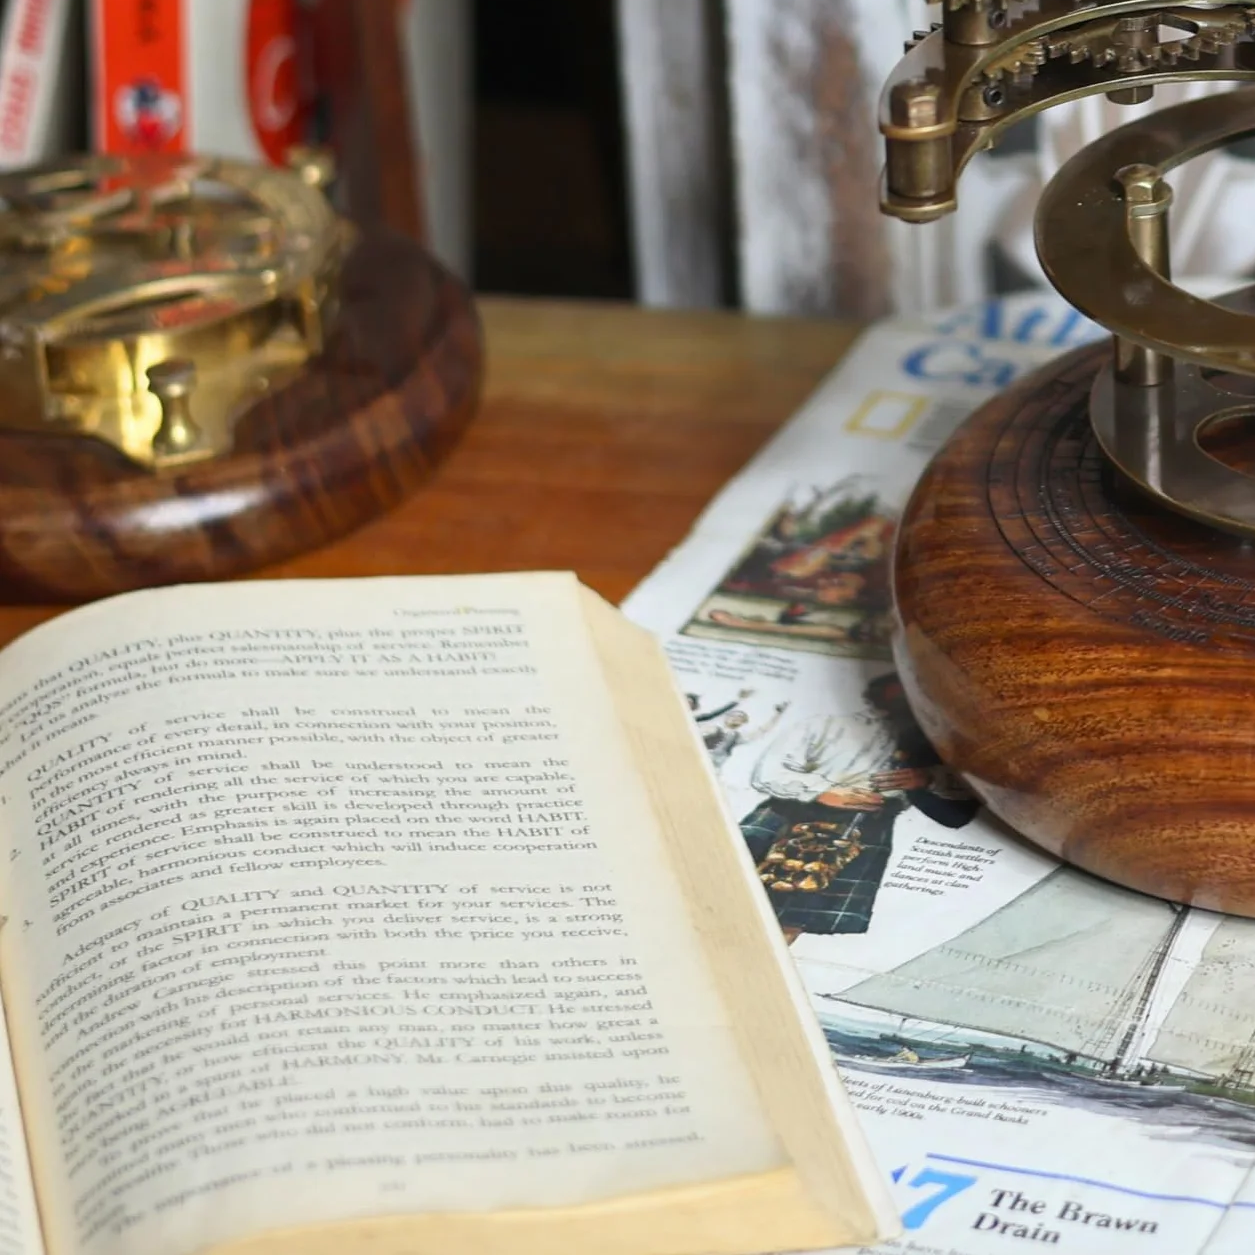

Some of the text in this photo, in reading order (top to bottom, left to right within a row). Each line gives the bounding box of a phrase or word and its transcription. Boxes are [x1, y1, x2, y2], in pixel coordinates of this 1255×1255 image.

[128, 722, 148, 735] of
[164, 711, 226, 725] service
[224, 777, 243, 787] all
[250, 776, 278, 785] the
[284, 775, 345, 784] service
[351, 774, 370, 783] of
[213, 805, 276, 819] greater
[282, 801, 318, 812] skill
[324, 801, 338, 810] is
[181, 819, 269, 836] Emphasis
[274, 817, 288, 826] is
[293, 815, 339, 827] again
[344, 814, 401, 826] placed
[406, 815, 430, 823] on
[435, 814, 463, 823] the
[468, 814, 513, 823] word
[910, 845, 952, 857] Scottish
[915, 836, 1003, 856] Descendants of
[897, 862, 923, 872] land
[958, 874, 983, 882] and
[180, 889, 281, 911] QUALITY
[290, 886, 324, 897] and
[901, 1167, 1160, 1235] 7 The Brawn
[970, 1212, 1061, 1245] Drain
